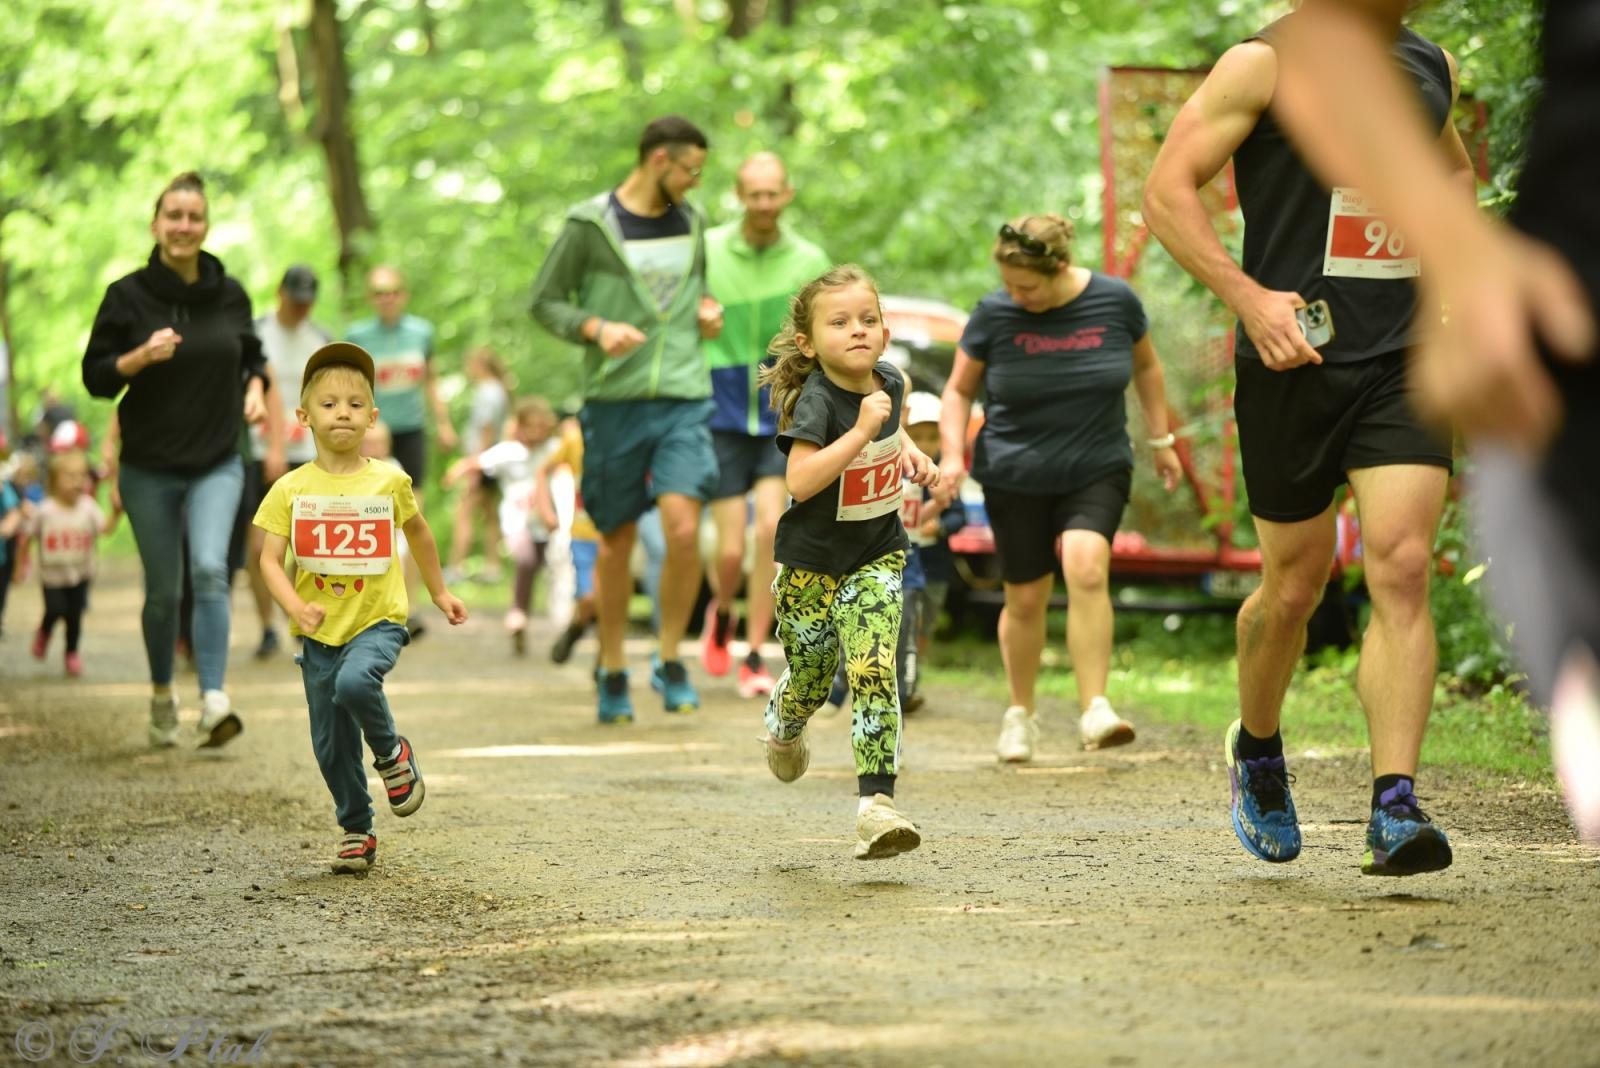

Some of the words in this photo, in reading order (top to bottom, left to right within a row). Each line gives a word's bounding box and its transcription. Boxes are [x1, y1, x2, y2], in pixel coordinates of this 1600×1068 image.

[1364, 220, 1405, 257] 96
[300, 500, 317, 511] Bieg
[364, 506, 382, 514] 4500
[311, 523, 378, 556] 125
